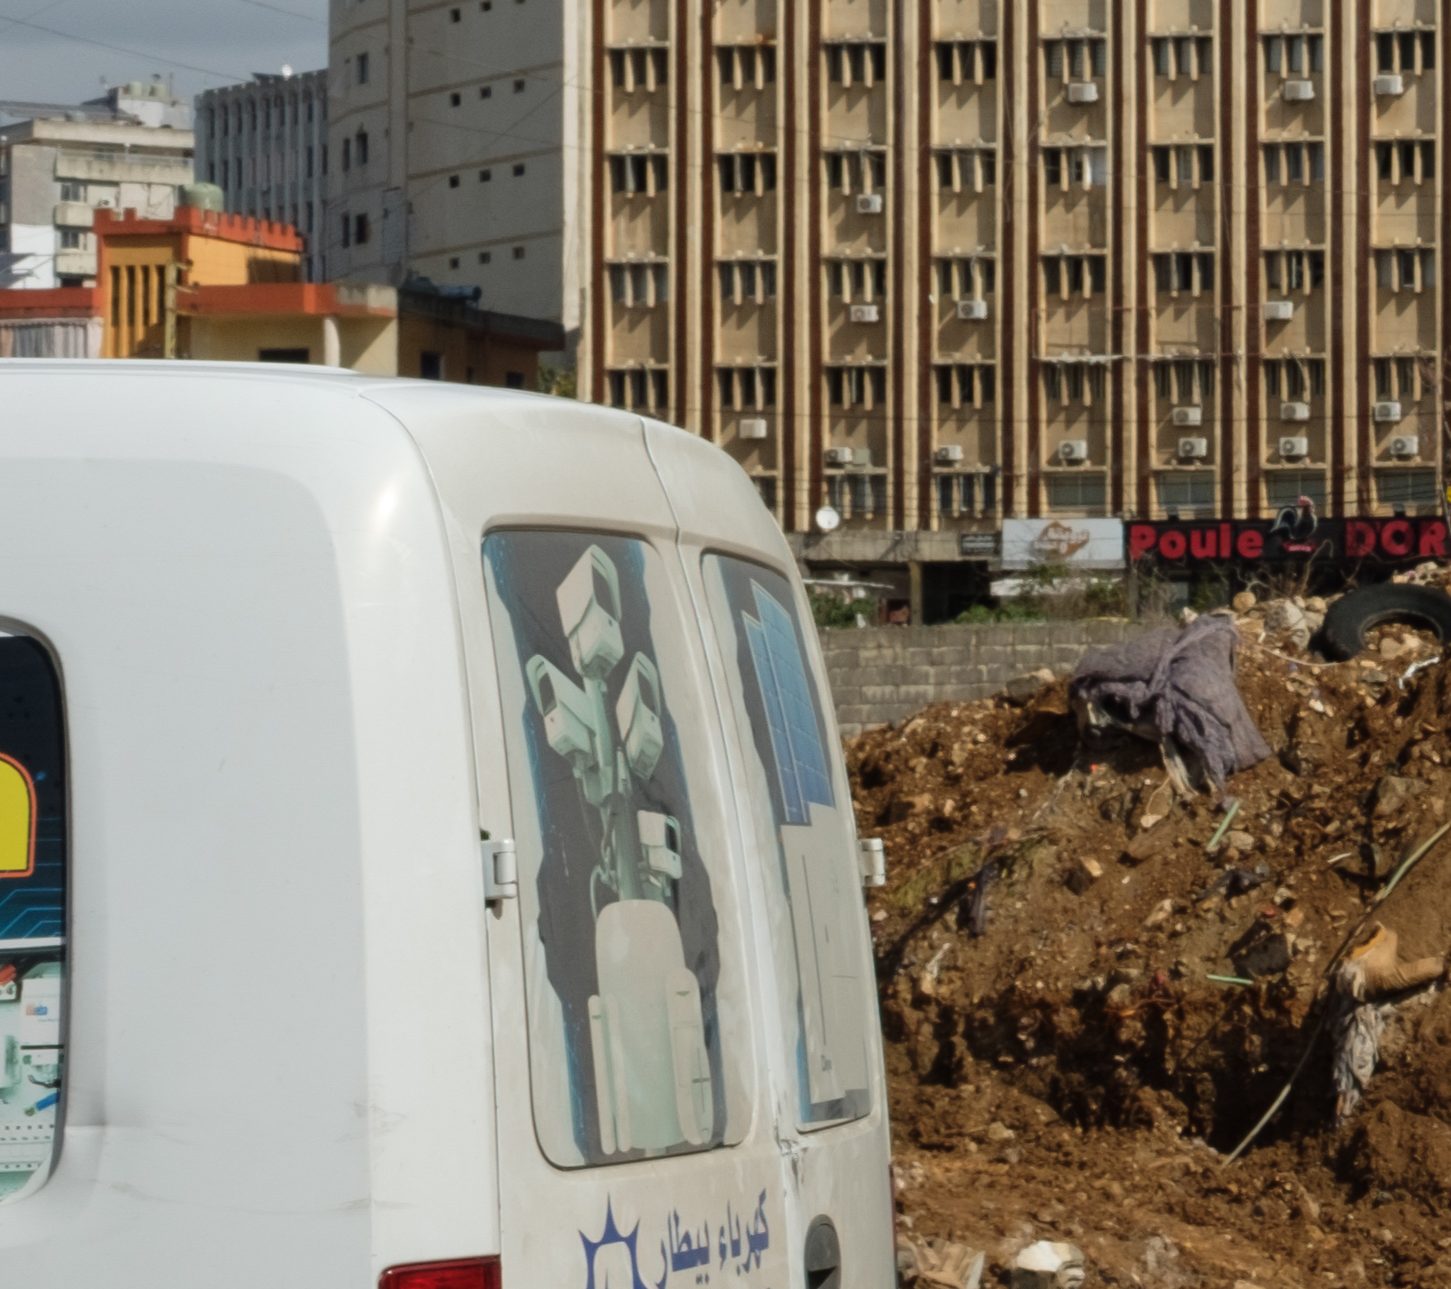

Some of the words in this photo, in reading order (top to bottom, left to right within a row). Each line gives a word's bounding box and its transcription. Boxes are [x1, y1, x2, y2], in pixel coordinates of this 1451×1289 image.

[1130, 522, 1264, 561] Poule
[1346, 520, 1447, 558] D'OR
[719, 1188, 769, 1277] كهرباء
